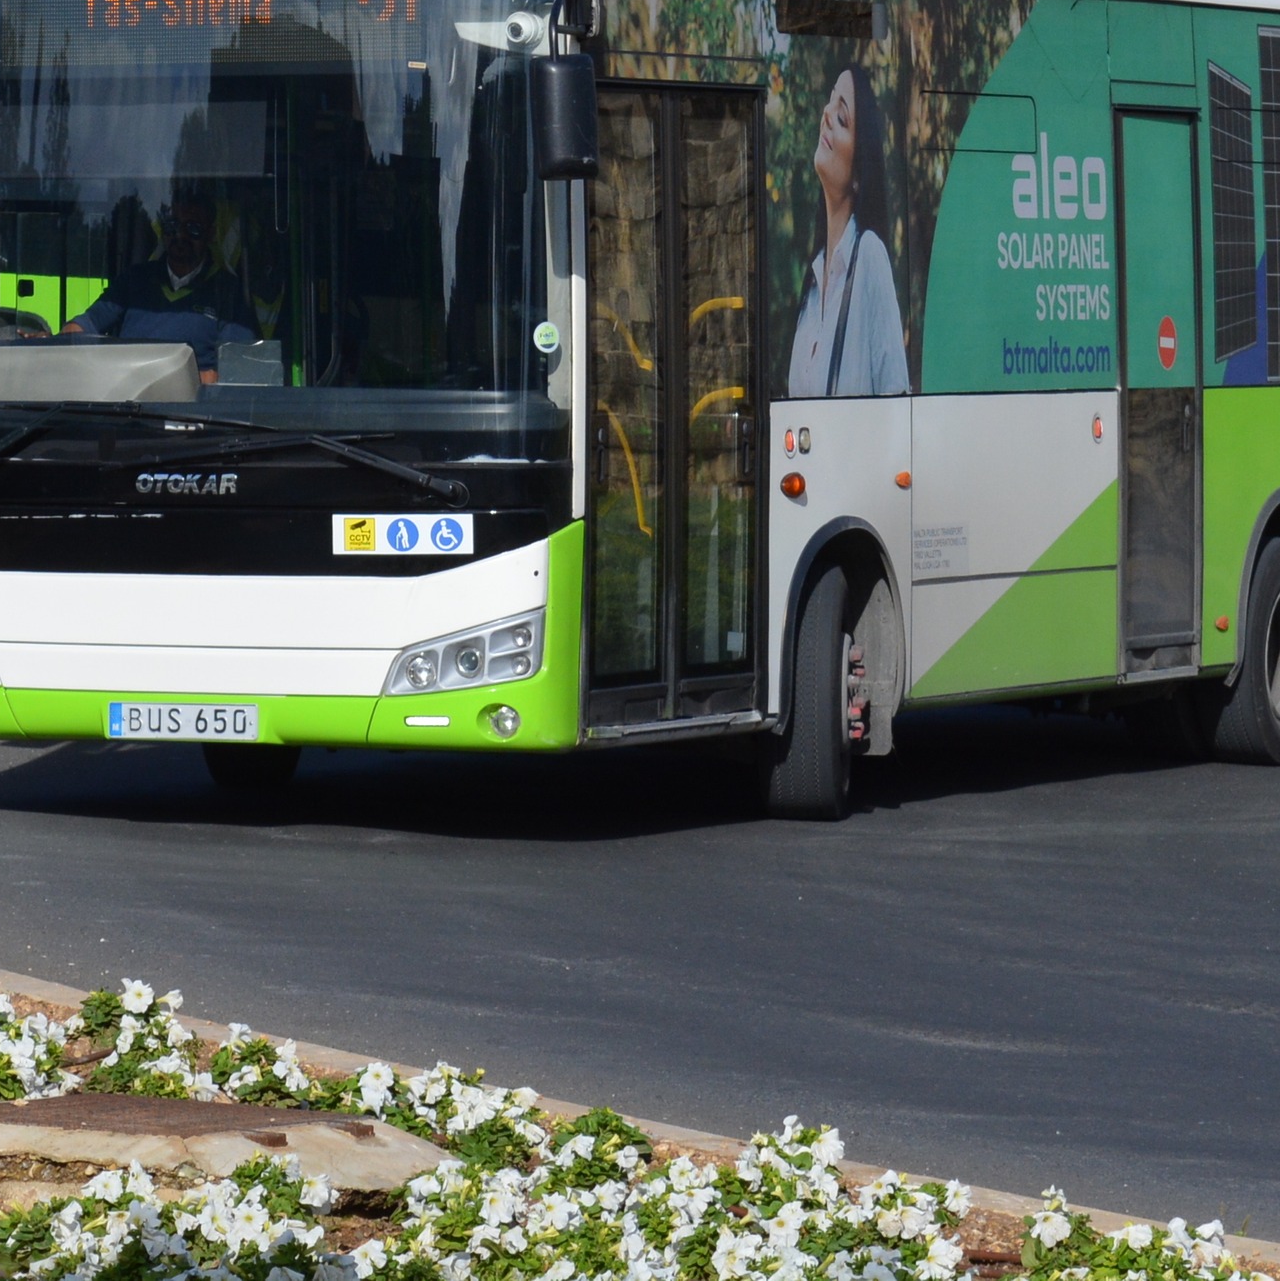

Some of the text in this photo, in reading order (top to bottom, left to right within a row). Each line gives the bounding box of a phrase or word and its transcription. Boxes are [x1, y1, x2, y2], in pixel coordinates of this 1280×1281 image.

[1011, 131, 1107, 220] aleo
[997, 231, 1110, 270] SOLAR PANEL
[1035, 283, 1110, 321] SYSTEMS
[1003, 335, 1111, 375] btmalta.com
[135, 473, 238, 495] OTOKAR
[349, 534, 371, 542] CCTV
[129, 707, 182, 733] BUS
[195, 708, 247, 734] 650
